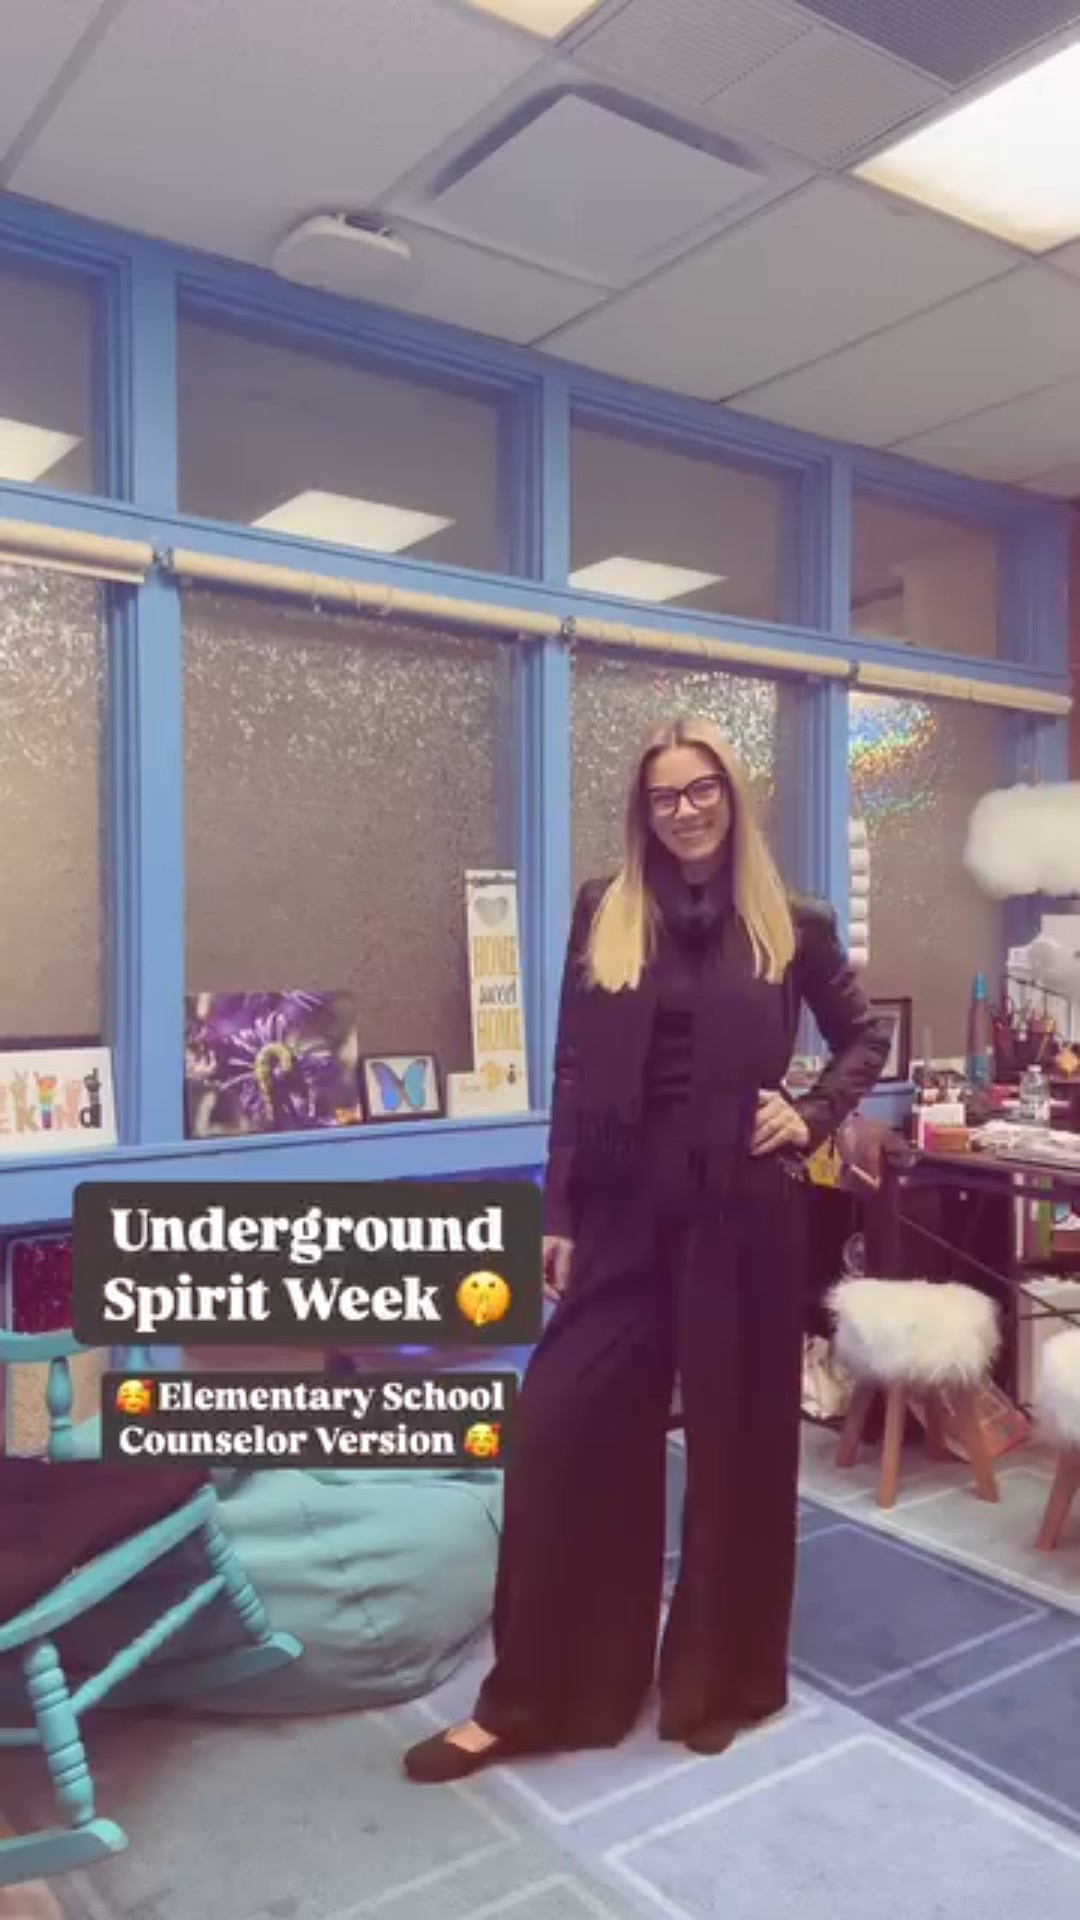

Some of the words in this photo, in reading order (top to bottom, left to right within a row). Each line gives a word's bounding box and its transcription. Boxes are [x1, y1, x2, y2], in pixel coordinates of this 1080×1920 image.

[473, 935, 517, 977] HOME
[479, 979, 517, 1006] sweet
[477, 1008, 521, 1051] HOME
